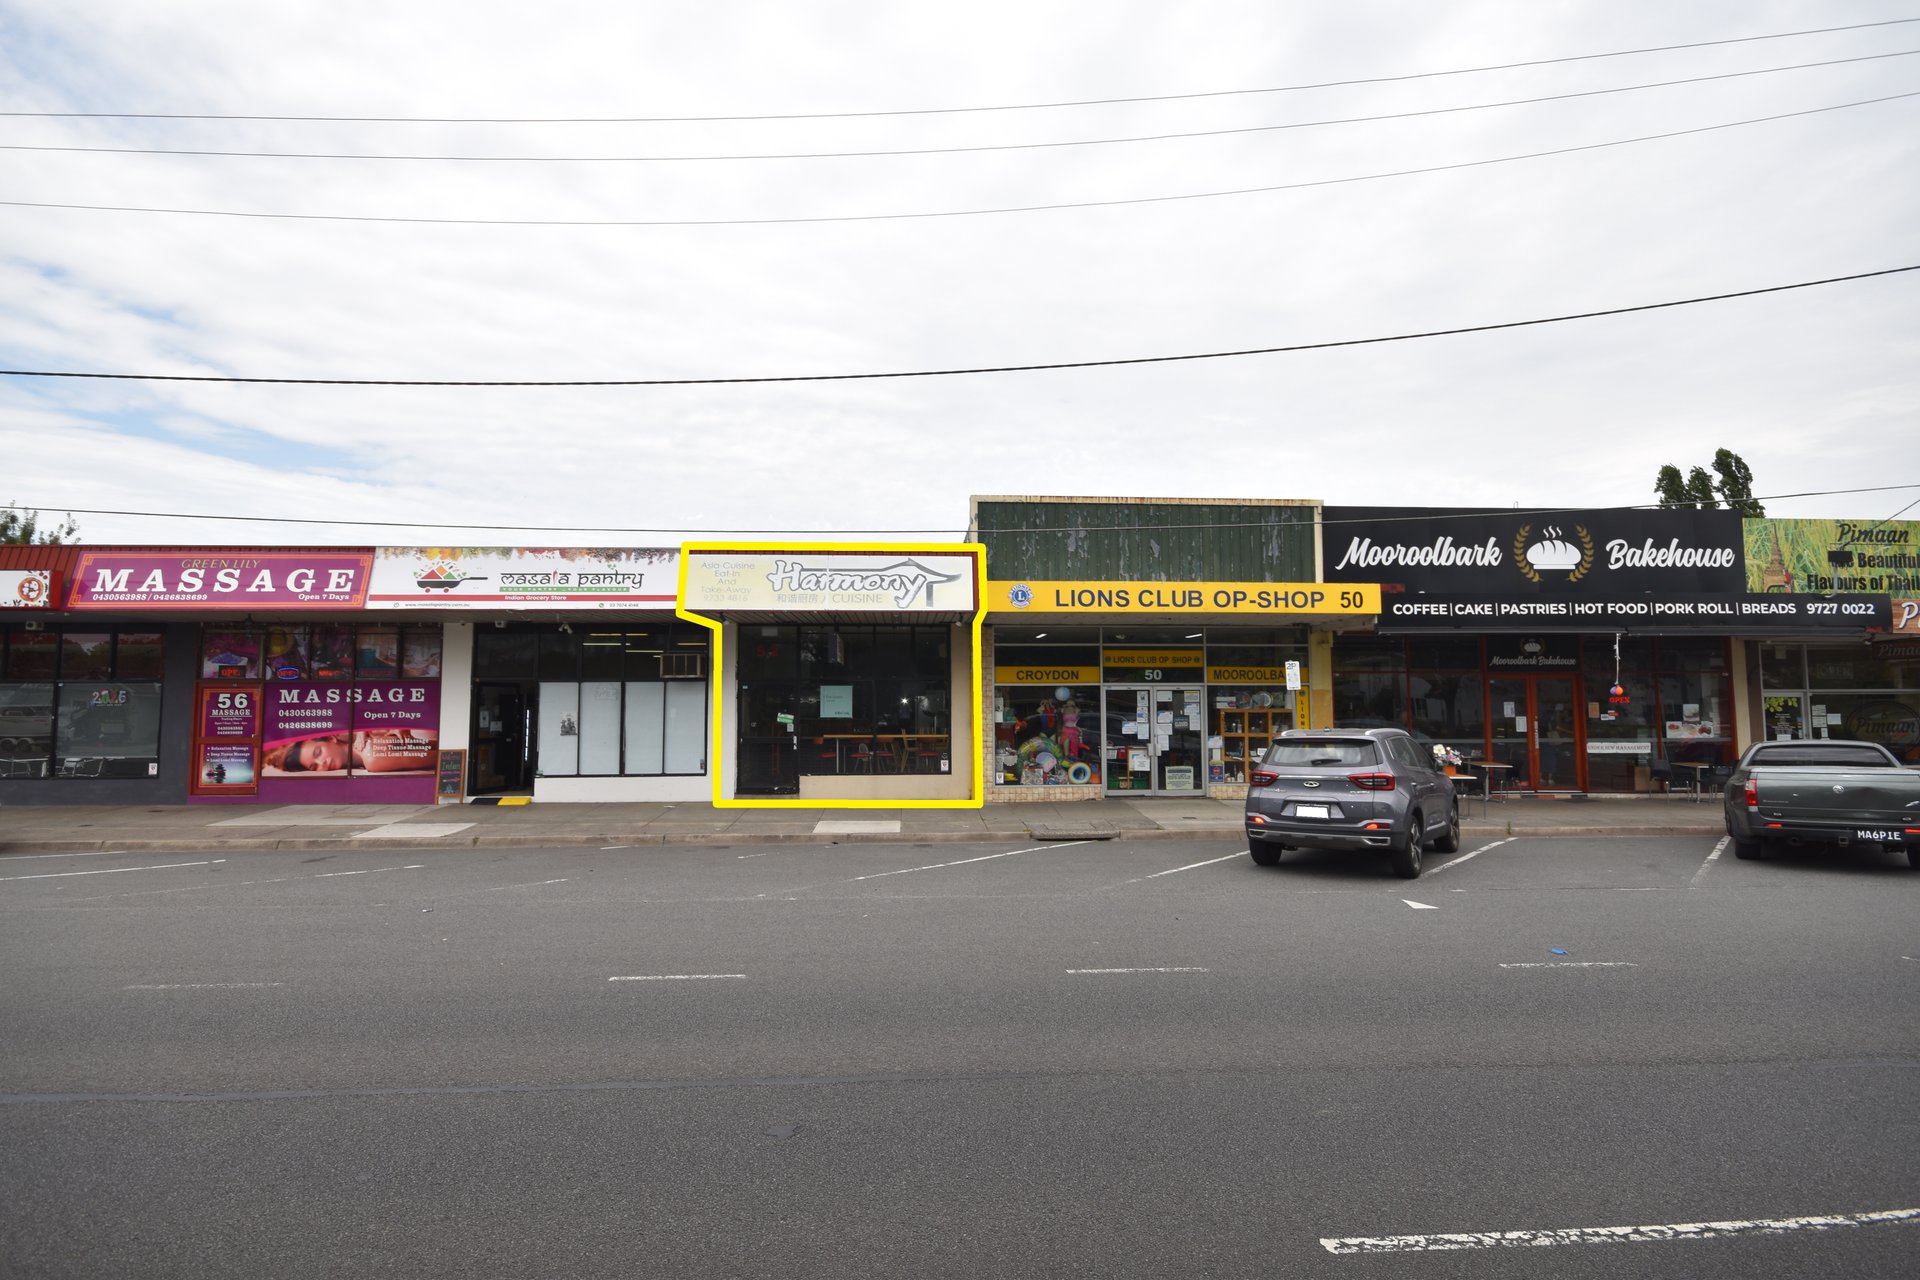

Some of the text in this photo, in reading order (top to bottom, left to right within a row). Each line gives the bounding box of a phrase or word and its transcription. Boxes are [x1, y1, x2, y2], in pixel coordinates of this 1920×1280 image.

[1838, 523, 1909, 544] Pimaan
[1335, 536, 1502, 570] Mooroolbark
[1606, 537, 1736, 570] Bakehouse
[181, 559, 261, 568] GREEN LILY
[90, 568, 355, 593] MASSAGE
[500, 568, 645, 589] masala pantry
[766, 560, 927, 609] Harmony
[1807, 574, 1920, 591] Flavours of Thail
[298, 594, 321, 602] Open
[329, 594, 350, 602] Days
[832, 593, 883, 603] CUISINE
[1055, 589, 1364, 609] LIONS CLUB OP-SHOP 50
[1393, 603, 1875, 615] COFFEE CAKE PASTRIES HOT FOOD PORK ROLL BREADS 9727 0022
[1898, 601, 1920, 629] P
[1113, 656, 1193, 664] LIONS CLUB OP SHOP
[1489, 656, 1576, 667] Mooroolbark Bakehouse
[1016, 670, 1079, 681] CROYDON
[1144, 669, 1162, 681] 50
[1213, 670, 1286, 681] MOOROOLBA
[217, 692, 248, 709] 56
[279, 688, 425, 703] MASSAGE
[1609, 696, 1630, 704] OPEN
[278, 709, 333, 717] 0430563988
[364, 711, 389, 720] Open
[398, 711, 421, 720] Days
[278, 721, 333, 729] 0426838699
[1856, 717, 1916, 734] Pimaan
